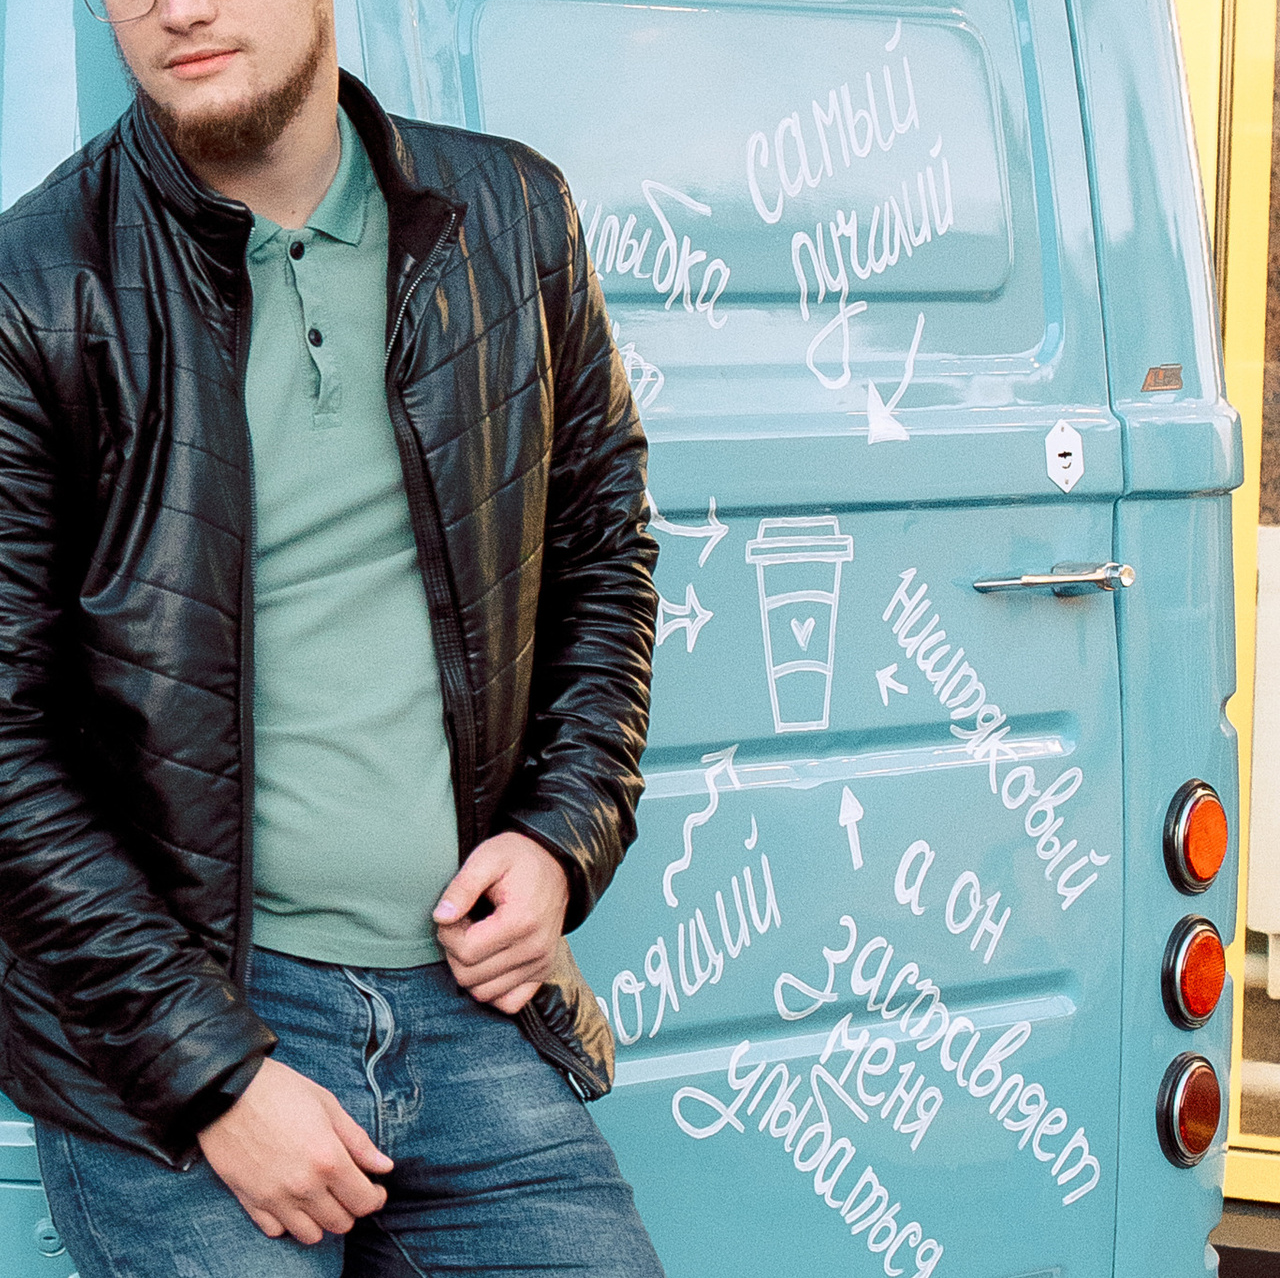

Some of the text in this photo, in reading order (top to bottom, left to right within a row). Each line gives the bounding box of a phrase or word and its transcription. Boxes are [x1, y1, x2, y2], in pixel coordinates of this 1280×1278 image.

[747, 19, 920, 224] самый
[791, 134, 954, 390] лучший
[882, 567, 1111, 911] ништяковый
[596, 814, 781, 1045] оящий
[894, 839, 1011, 964] а он
[774, 915, 1101, 1206] заставляет
[819, 1013, 943, 1151] меня
